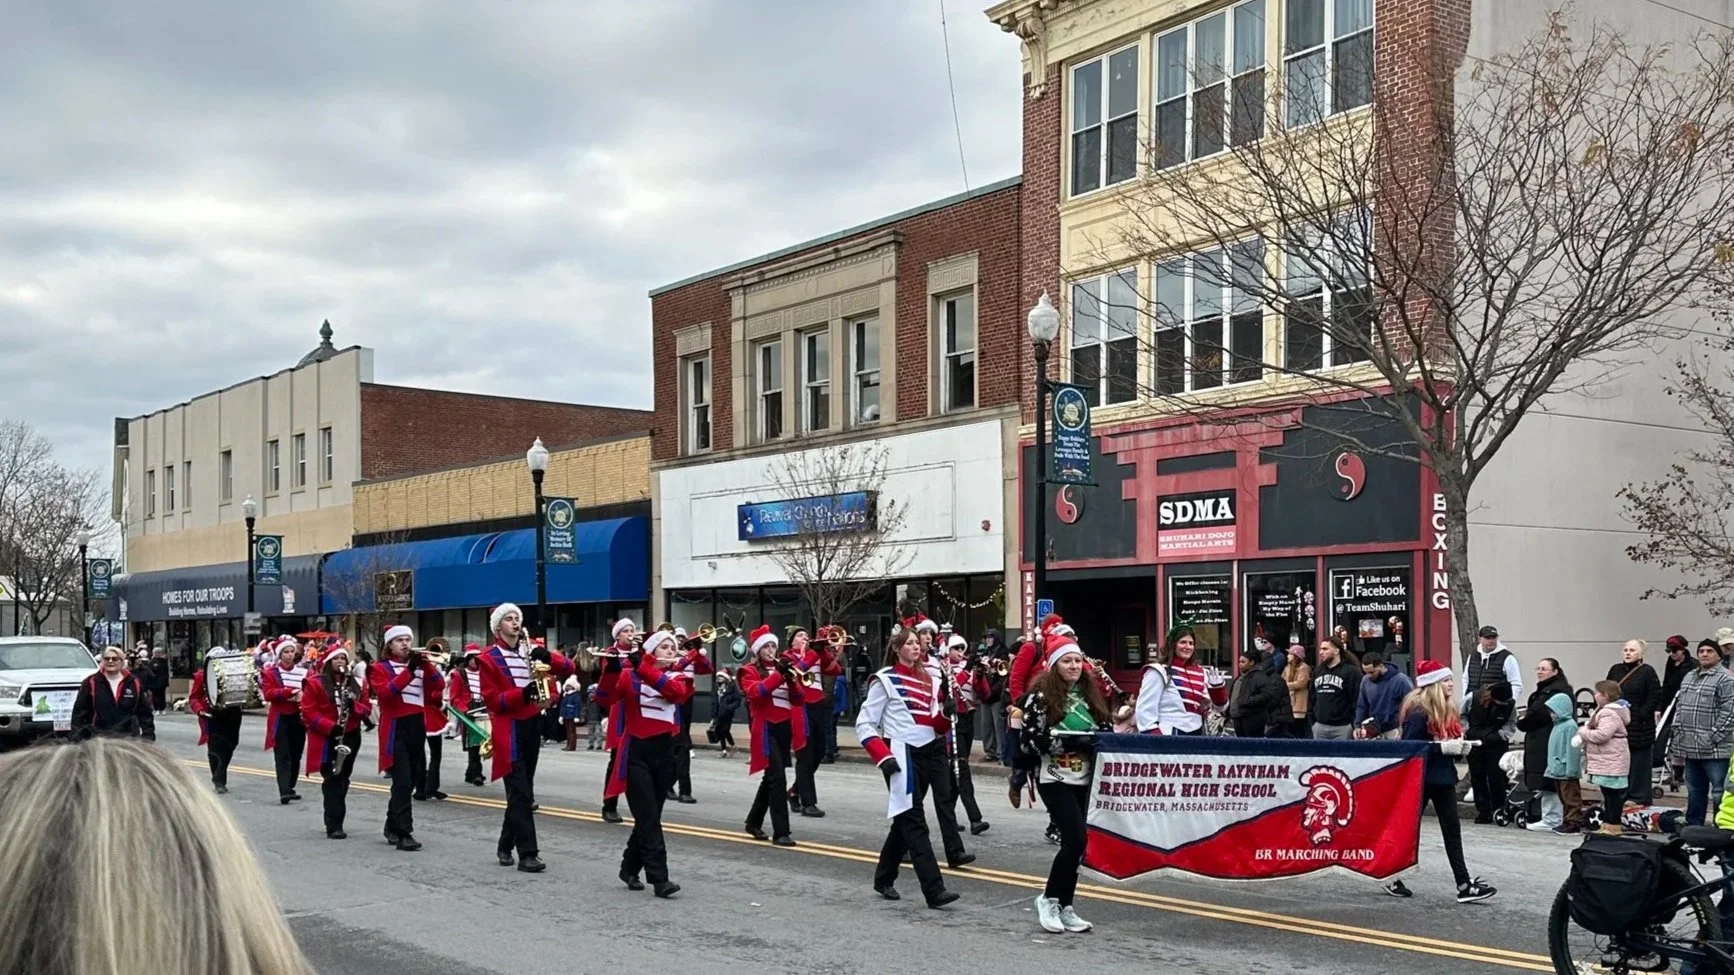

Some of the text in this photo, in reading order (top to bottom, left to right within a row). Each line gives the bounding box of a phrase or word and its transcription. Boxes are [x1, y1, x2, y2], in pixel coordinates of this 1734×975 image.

[1159, 497, 1235, 525] SDMA
[1208, 531, 1235, 539] DOJO
[1366, 576, 1380, 584] Like
[162, 586, 234, 604] HOMES FOR OUR TROOPS
[1356, 584, 1406, 596] Facebook
[168, 607, 183, 618] Building
[217, 606, 228, 614] Lives
[1336, 601, 1406, 614] @ TeamShuhari
[1102, 762, 1290, 779] BRIDGEWATER RAYNHAM
[1098, 781, 1277, 798] REGIONAL HIGH SCHOOL
[1096, 800, 1249, 812] BRIDGEWATER, MASSACHUSETTS
[1255, 849, 1374, 860] BR MARCHING BAND
